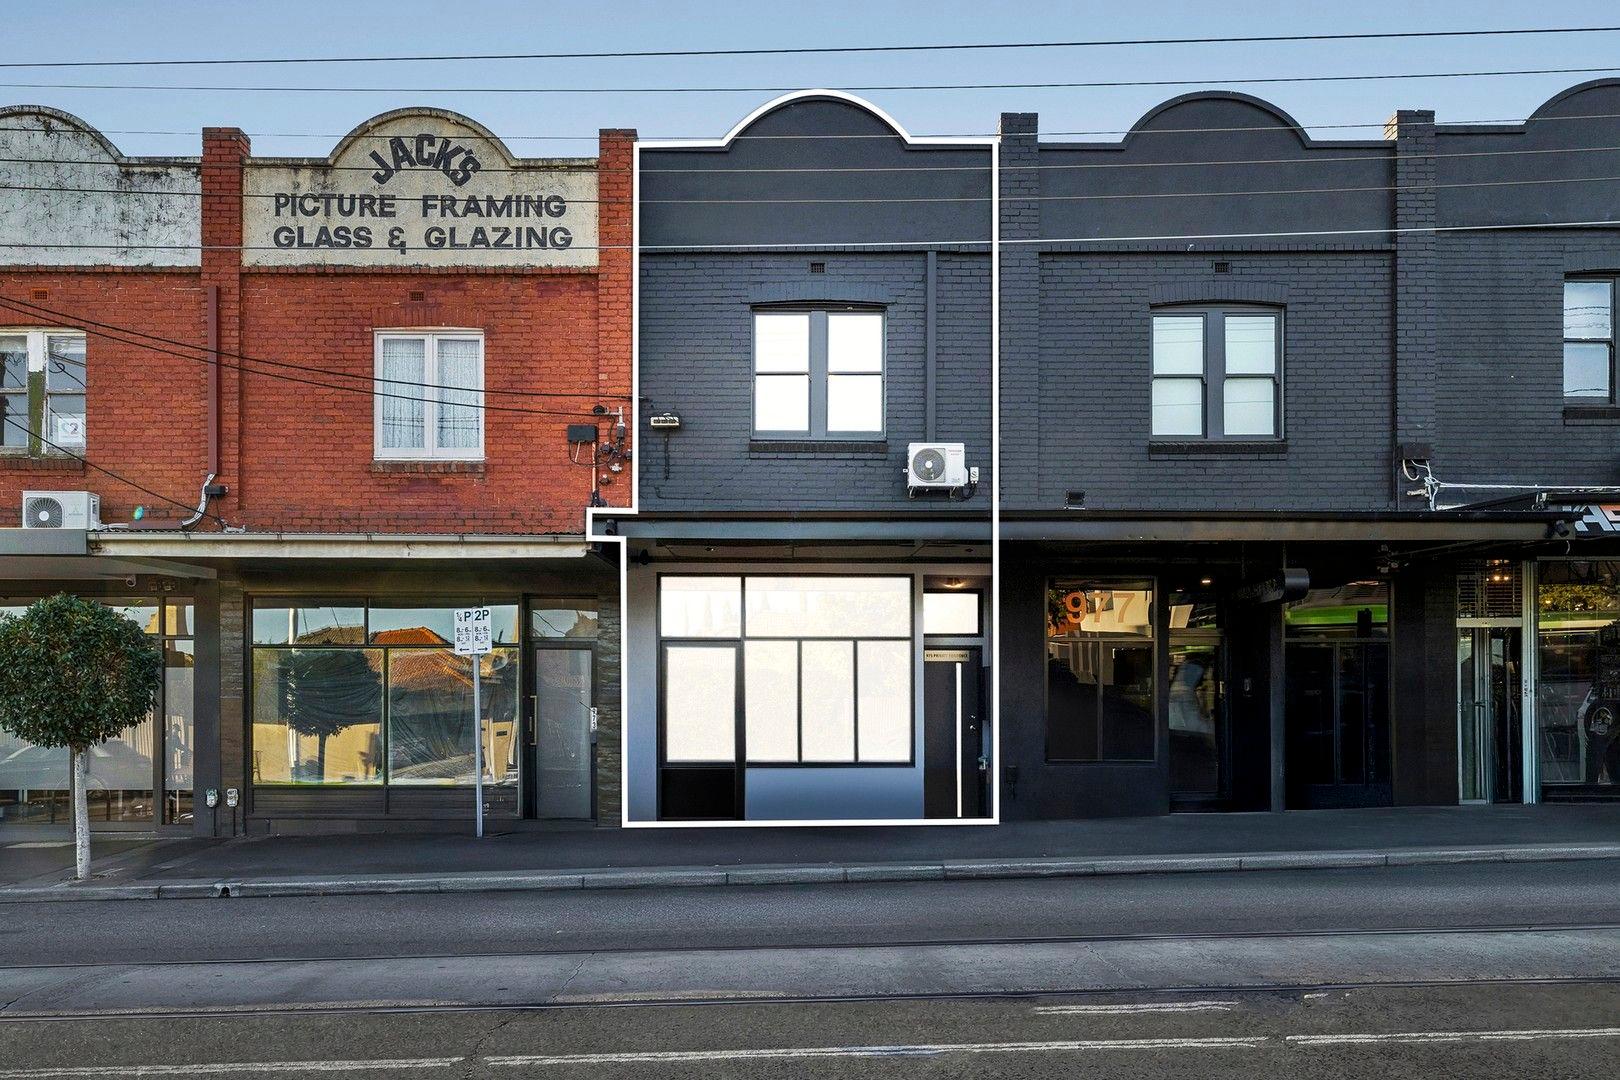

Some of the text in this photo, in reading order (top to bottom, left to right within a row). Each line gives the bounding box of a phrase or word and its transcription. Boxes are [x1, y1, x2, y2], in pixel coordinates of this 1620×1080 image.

[368, 133, 482, 187] JACK'S
[274, 192, 567, 218] PICTURE FRAMING
[273, 225, 573, 255] GLASS & GLAZING
[474, 609, 490, 621] 2P
[1065, 591, 1135, 624] 977
